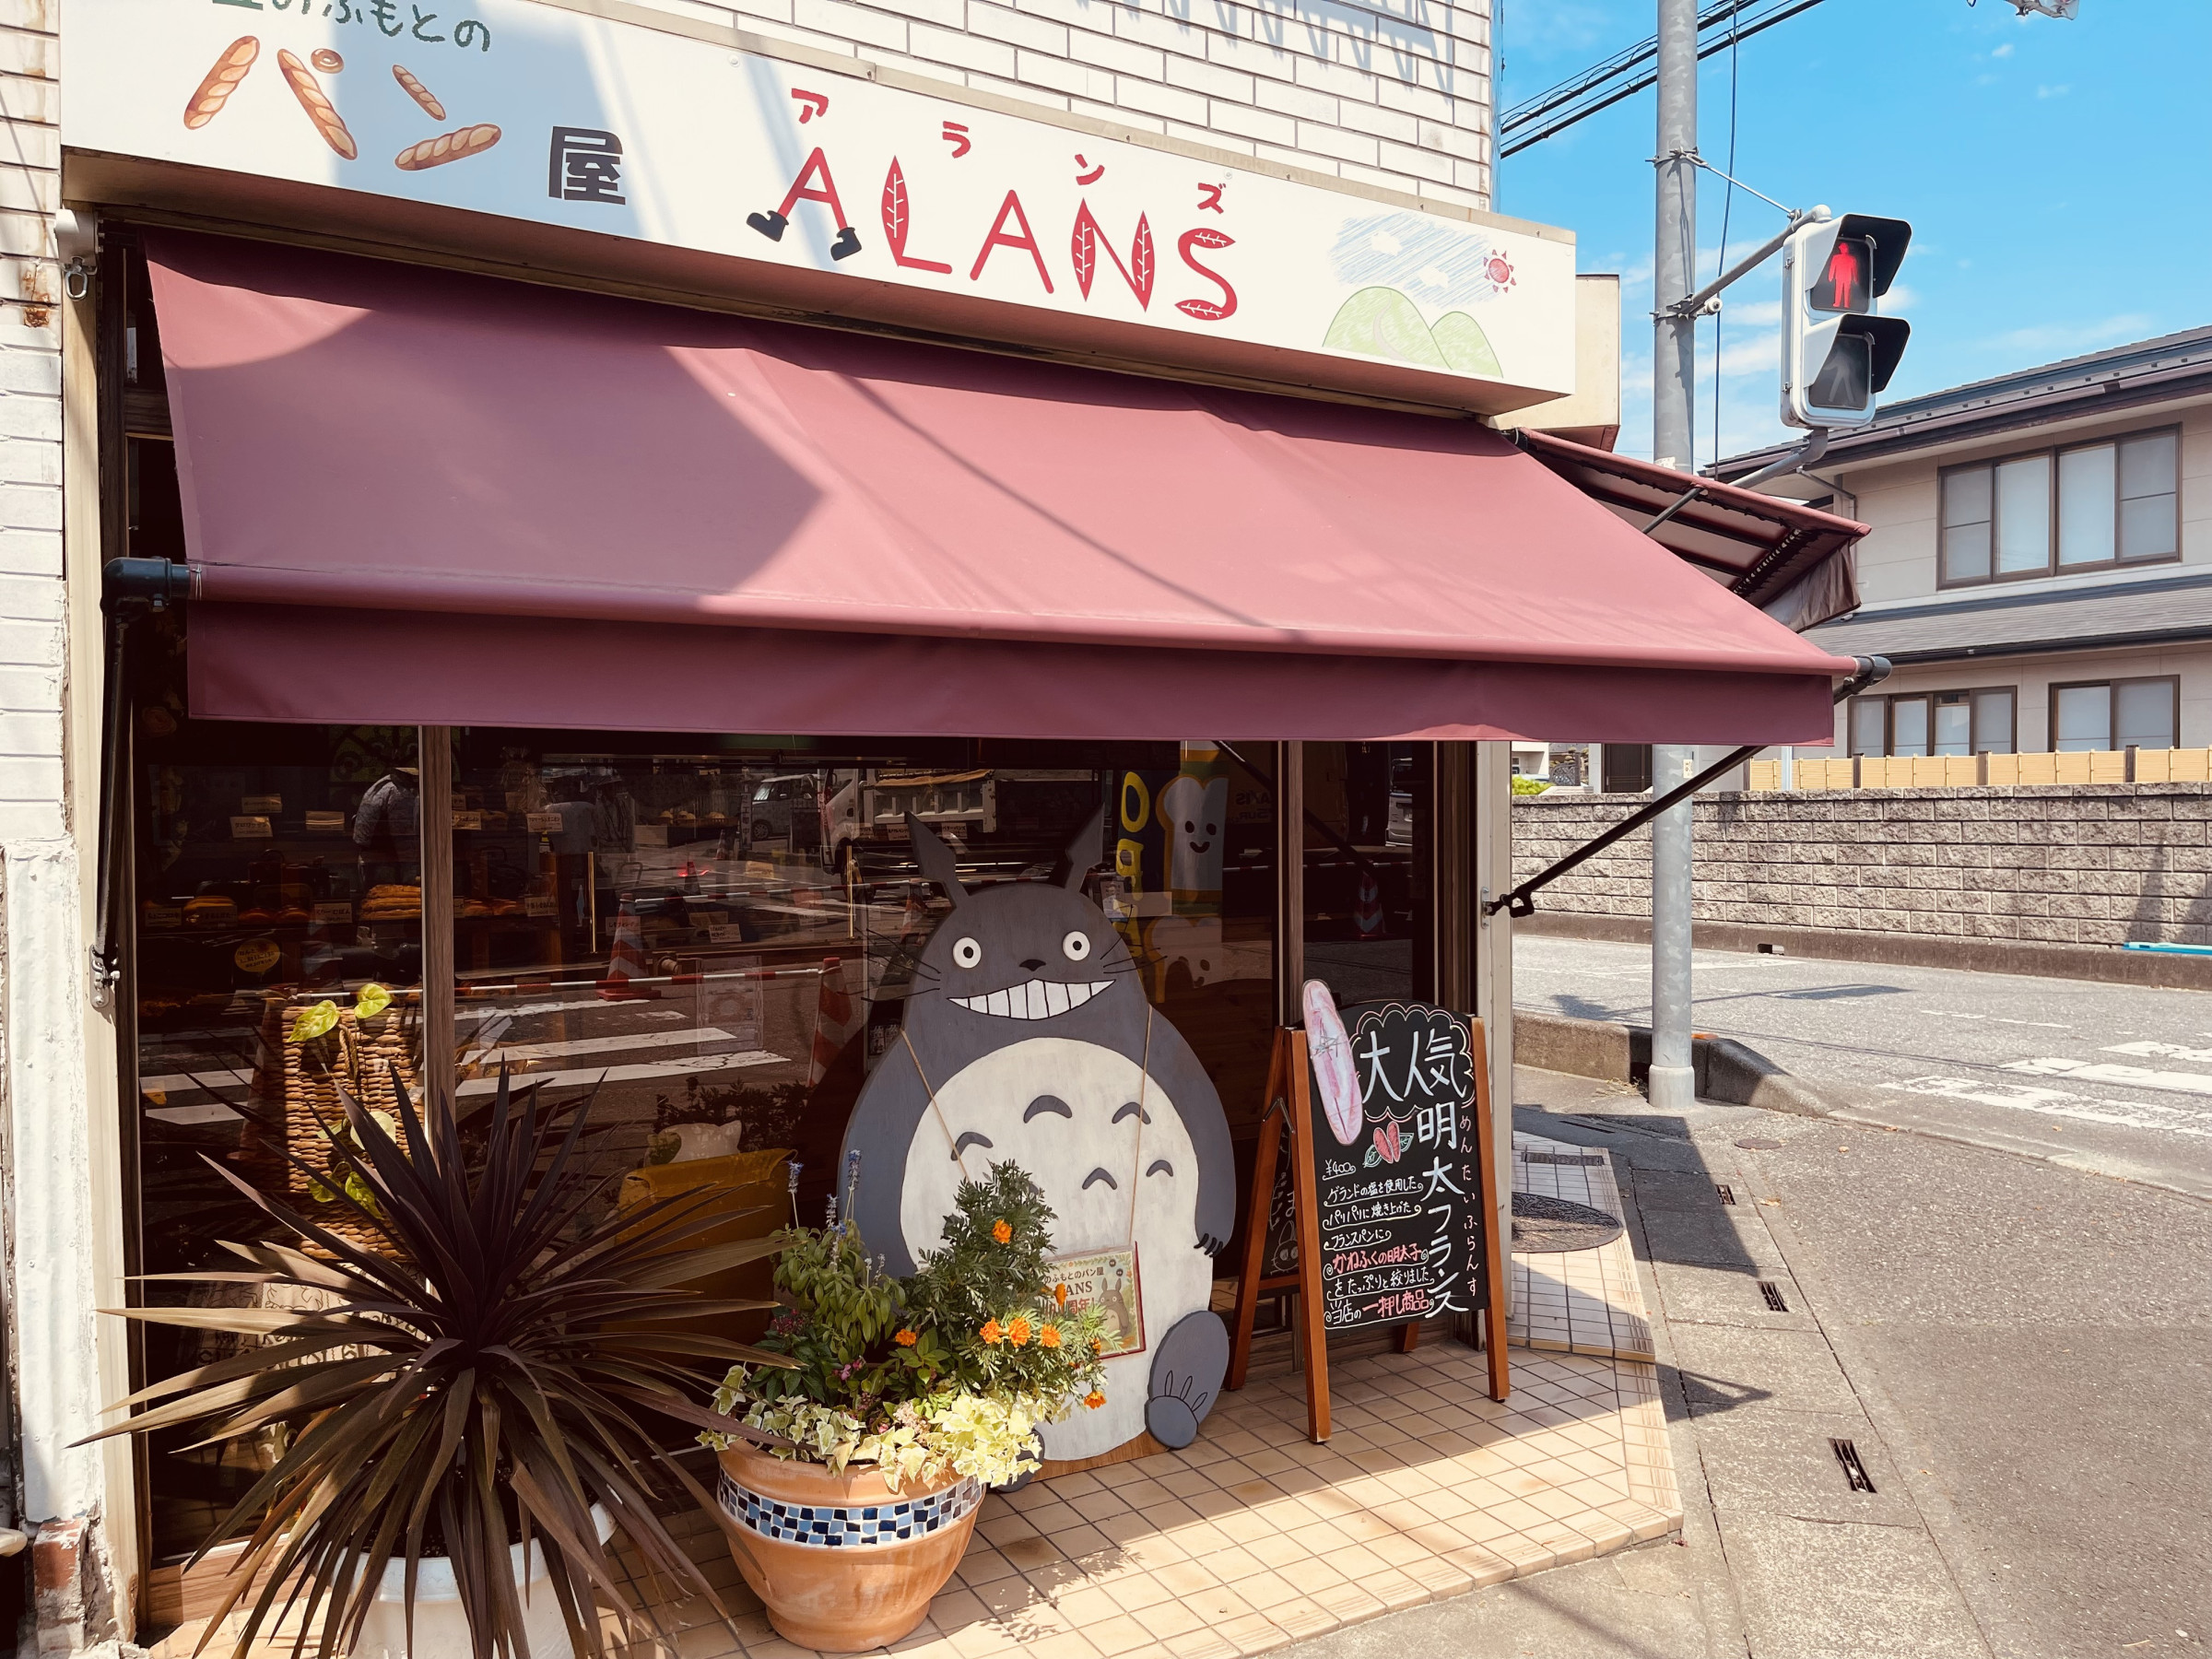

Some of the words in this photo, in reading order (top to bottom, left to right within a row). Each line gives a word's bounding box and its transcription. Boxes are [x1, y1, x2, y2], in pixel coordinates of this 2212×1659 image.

[212, 0, 490, 53] ふもとの
[183, 35, 626, 206] パン屋
[791, 88, 1227, 214] アランズ
[746, 147, 1238, 321] ALANS
[1360, 1030, 1466, 1103] 大人気
[1327, 1175, 1418, 1204] ゲランドの塩を使用した
[1458, 1115, 1480, 1297] めんたいふらんす
[1329, 1200, 1412, 1227] パリパリに焼き上げた
[1417, 1101, 1469, 1319] 明太フランス
[1331, 1229, 1384, 1248] フランスパンに
[1043, 1266, 1104, 1284] のふもとのパン屋
[1332, 1242, 1422, 1274] かねふくの明太子
[1065, 1280, 1093, 1296] ANS
[1334, 1265, 1430, 1298] をたっぷりと絞りました
[1329, 1288, 1430, 1325] 当店の一押し商品
